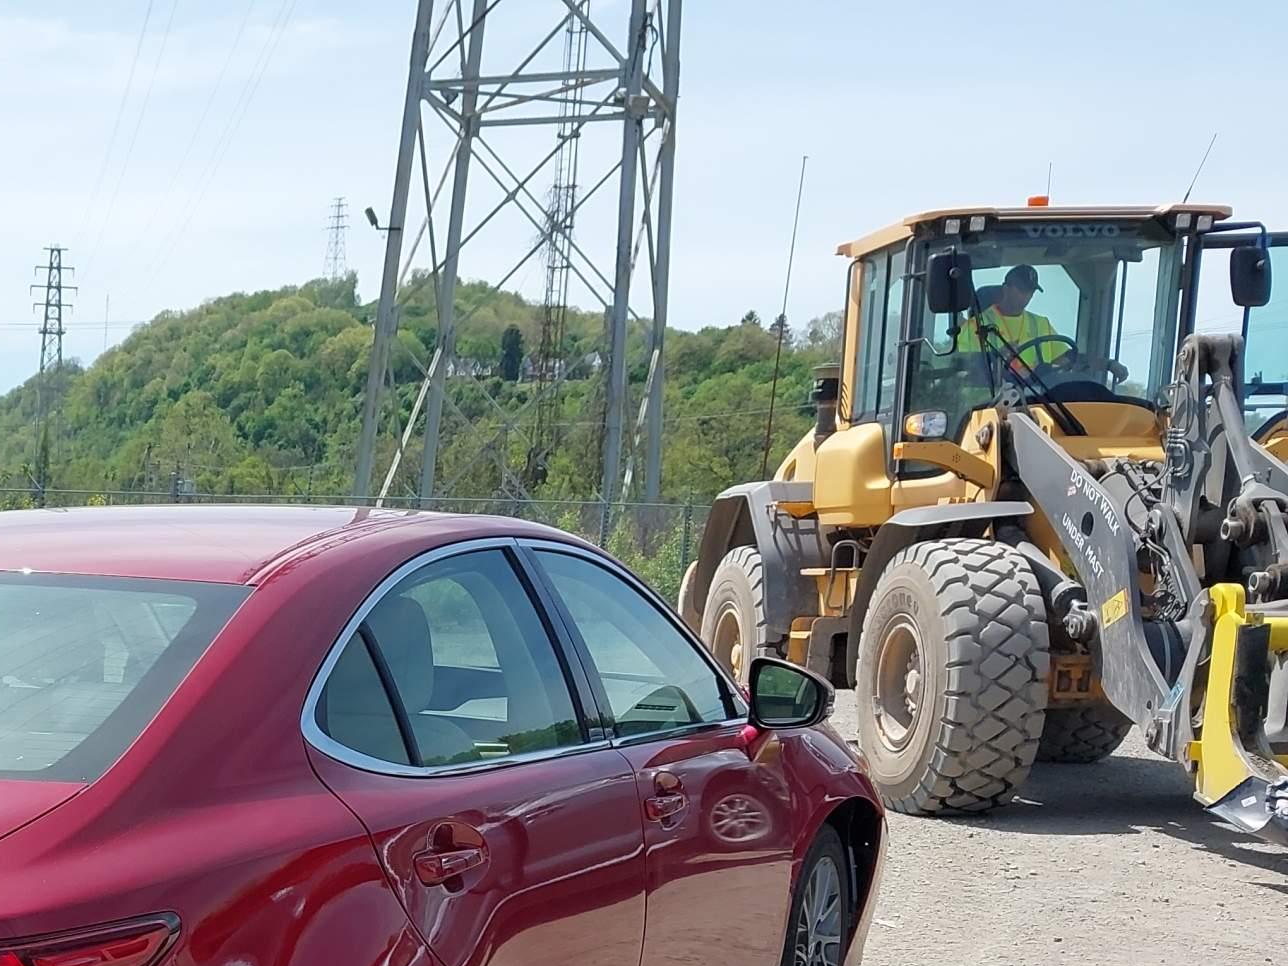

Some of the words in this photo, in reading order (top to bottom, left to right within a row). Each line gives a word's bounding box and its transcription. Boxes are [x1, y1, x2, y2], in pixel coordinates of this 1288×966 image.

[1020, 223, 1121, 238] VOLVO
[1071, 469, 1083, 488] DO
[1082, 482, 1101, 505] NOT
[1099, 495, 1120, 537] WALK
[1062, 512, 1085, 553] UNDER
[1085, 545, 1105, 579] MAST
